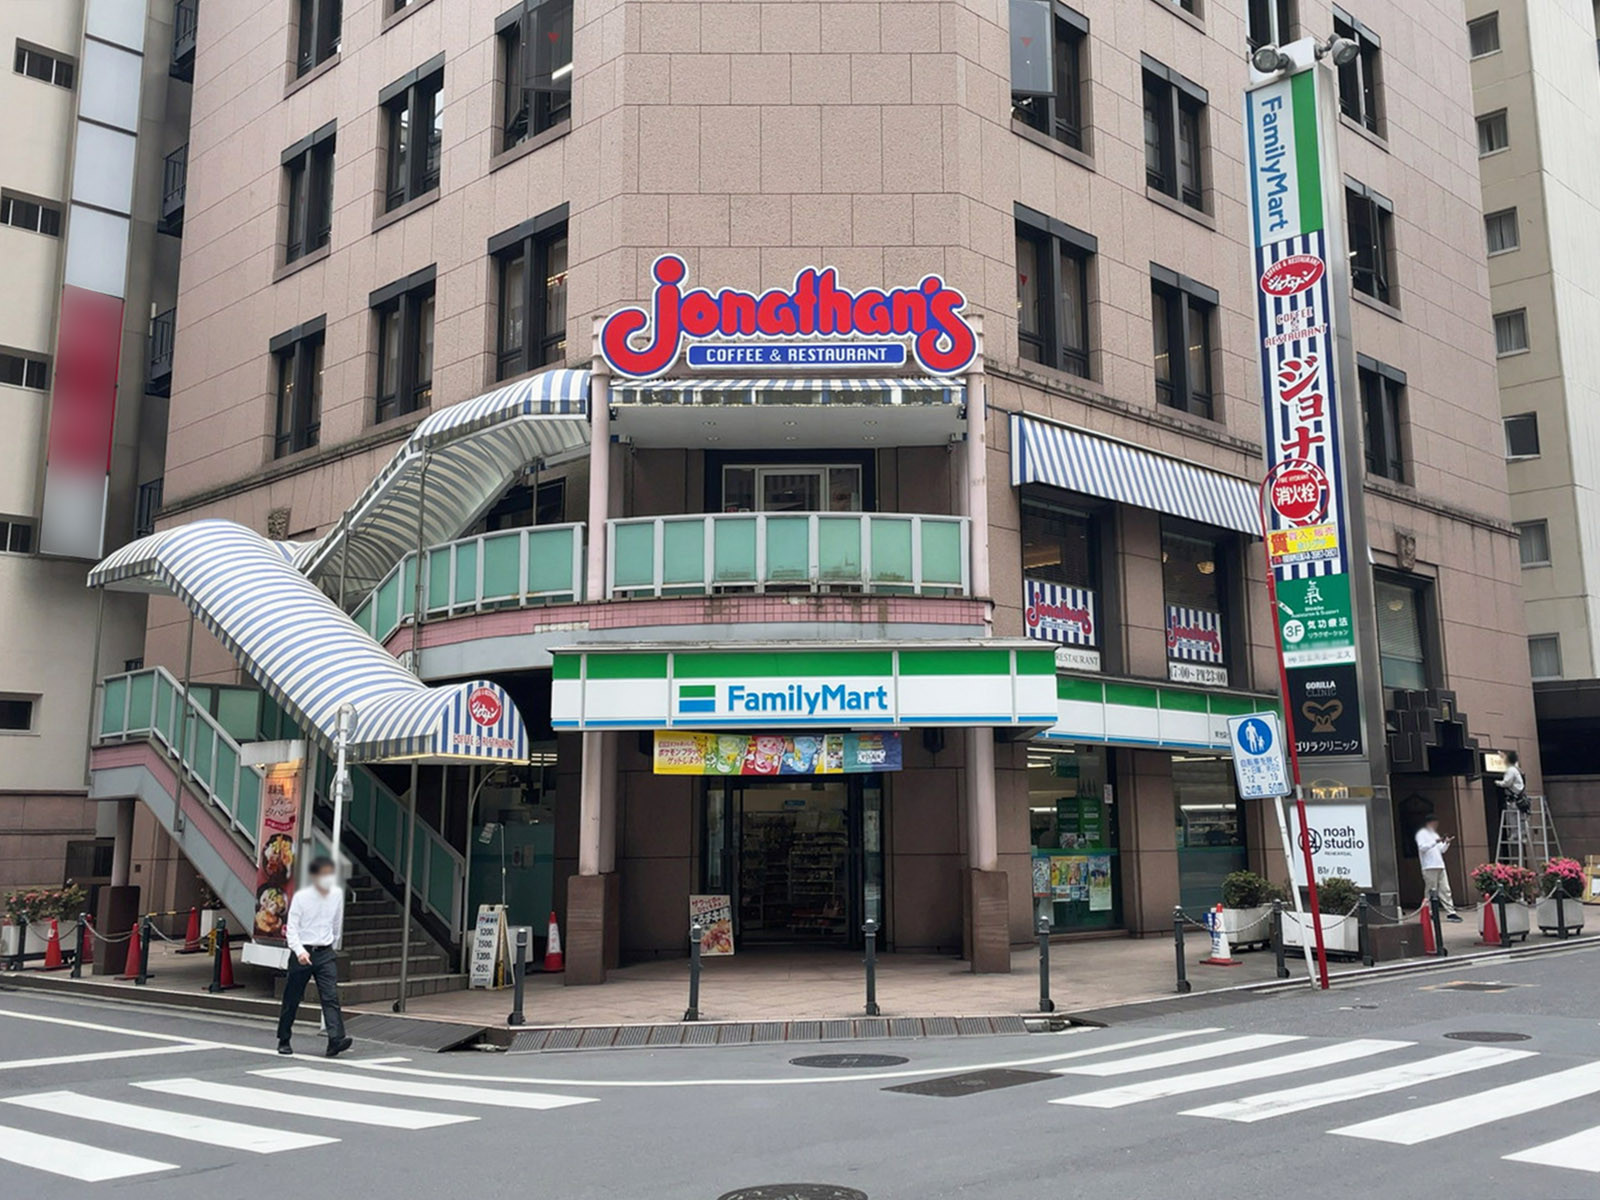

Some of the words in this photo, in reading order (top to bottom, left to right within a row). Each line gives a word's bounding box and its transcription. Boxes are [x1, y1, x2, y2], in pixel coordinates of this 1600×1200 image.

[1260, 95, 1289, 233] FamilyMart
[1276, 306, 1314, 325] COFFEE
[1264, 323, 1328, 348] RESTAURANT
[706, 348, 764, 363] COFFEE
[769, 350, 782, 362] &
[788, 347, 888, 362] RESTAURANT
[1275, 482, 1317, 507] 消火栓
[1285, 624, 1302, 638] 3F
[1305, 680, 1336, 690] GORILLA
[1305, 688, 1337, 697] CLINIC
[728, 684, 888, 715] FamilyMart
[1323, 826, 1355, 837] noah
[1324, 837, 1365, 849] studio
